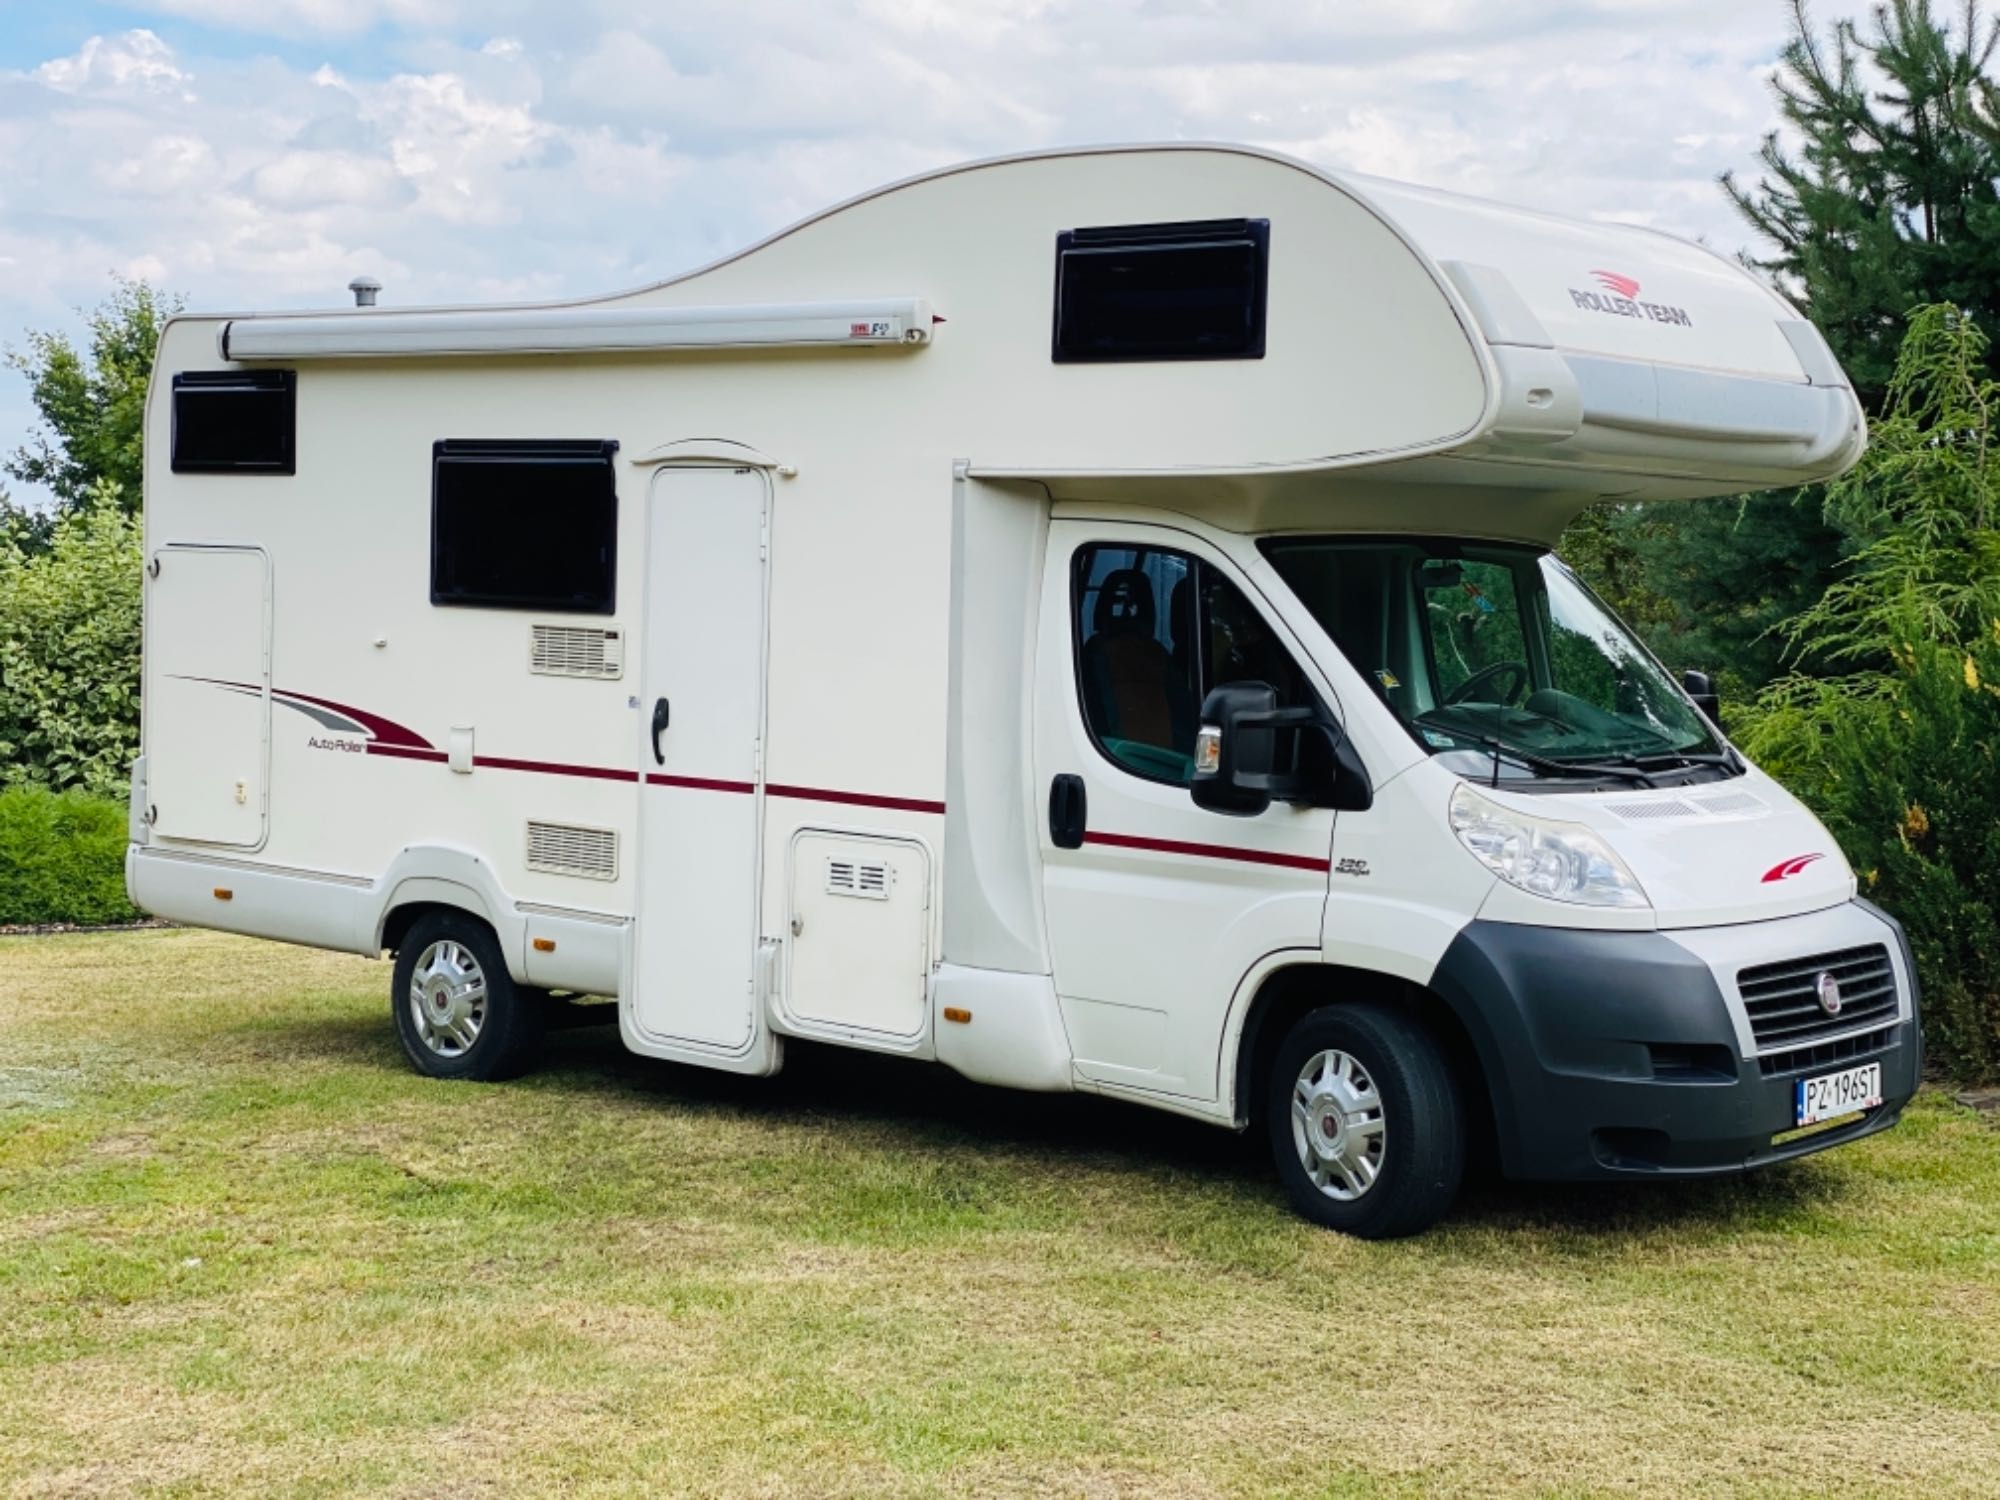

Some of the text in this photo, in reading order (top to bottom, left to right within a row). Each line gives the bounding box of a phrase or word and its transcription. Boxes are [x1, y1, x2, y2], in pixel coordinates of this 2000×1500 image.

[1568, 288, 1692, 327] ROLLER TEAM
[308, 736, 334, 751] Auto
[1807, 1066, 1877, 1112] PZ 196ST
